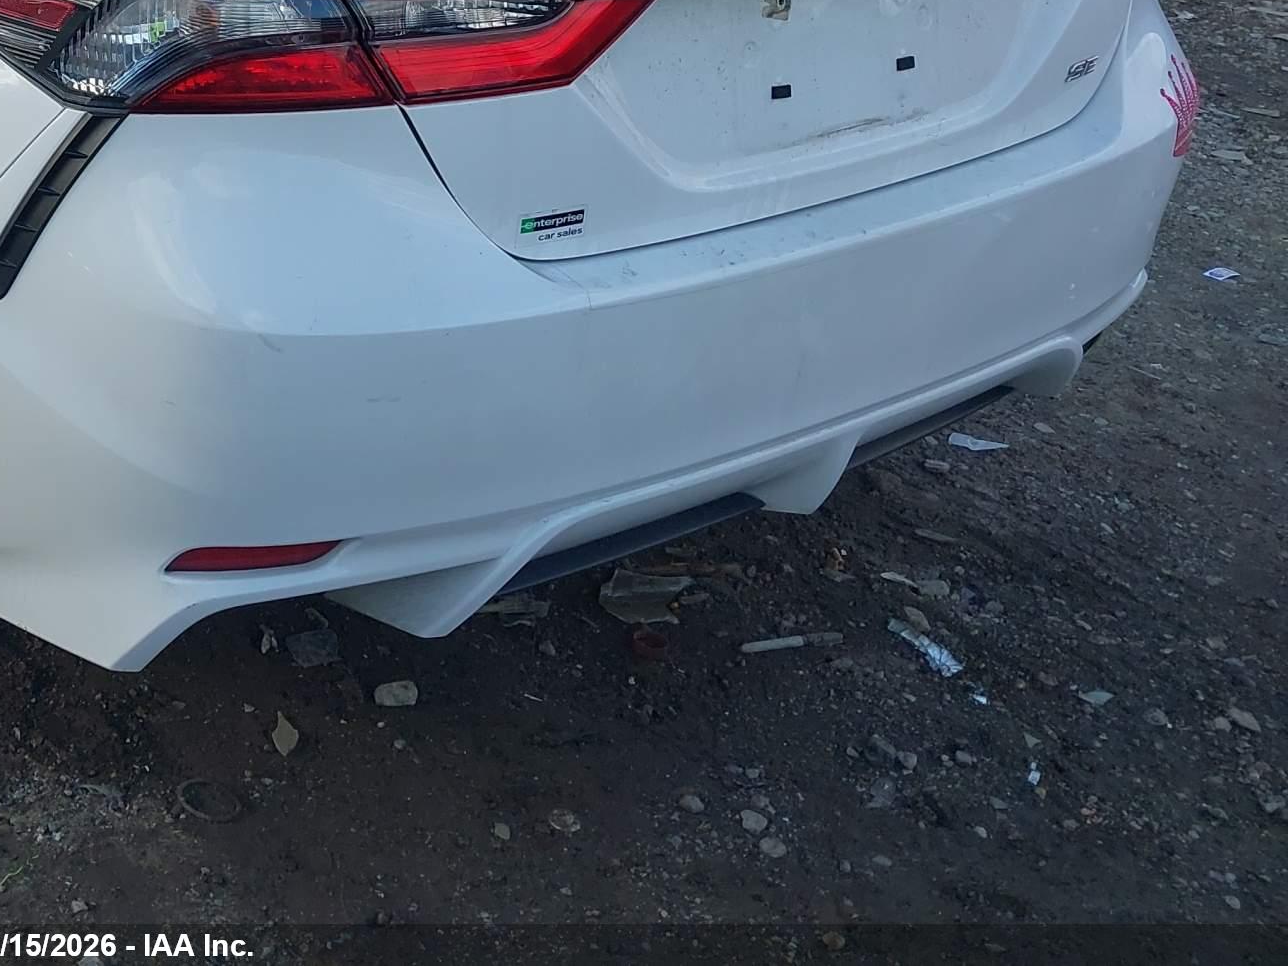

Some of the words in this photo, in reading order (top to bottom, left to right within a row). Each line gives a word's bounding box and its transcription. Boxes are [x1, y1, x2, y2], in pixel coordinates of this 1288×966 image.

[1064, 55, 1099, 83] SE
[522, 213, 584, 229] enterprise
[538, 232, 555, 241] car
[556, 228, 584, 239] sales
